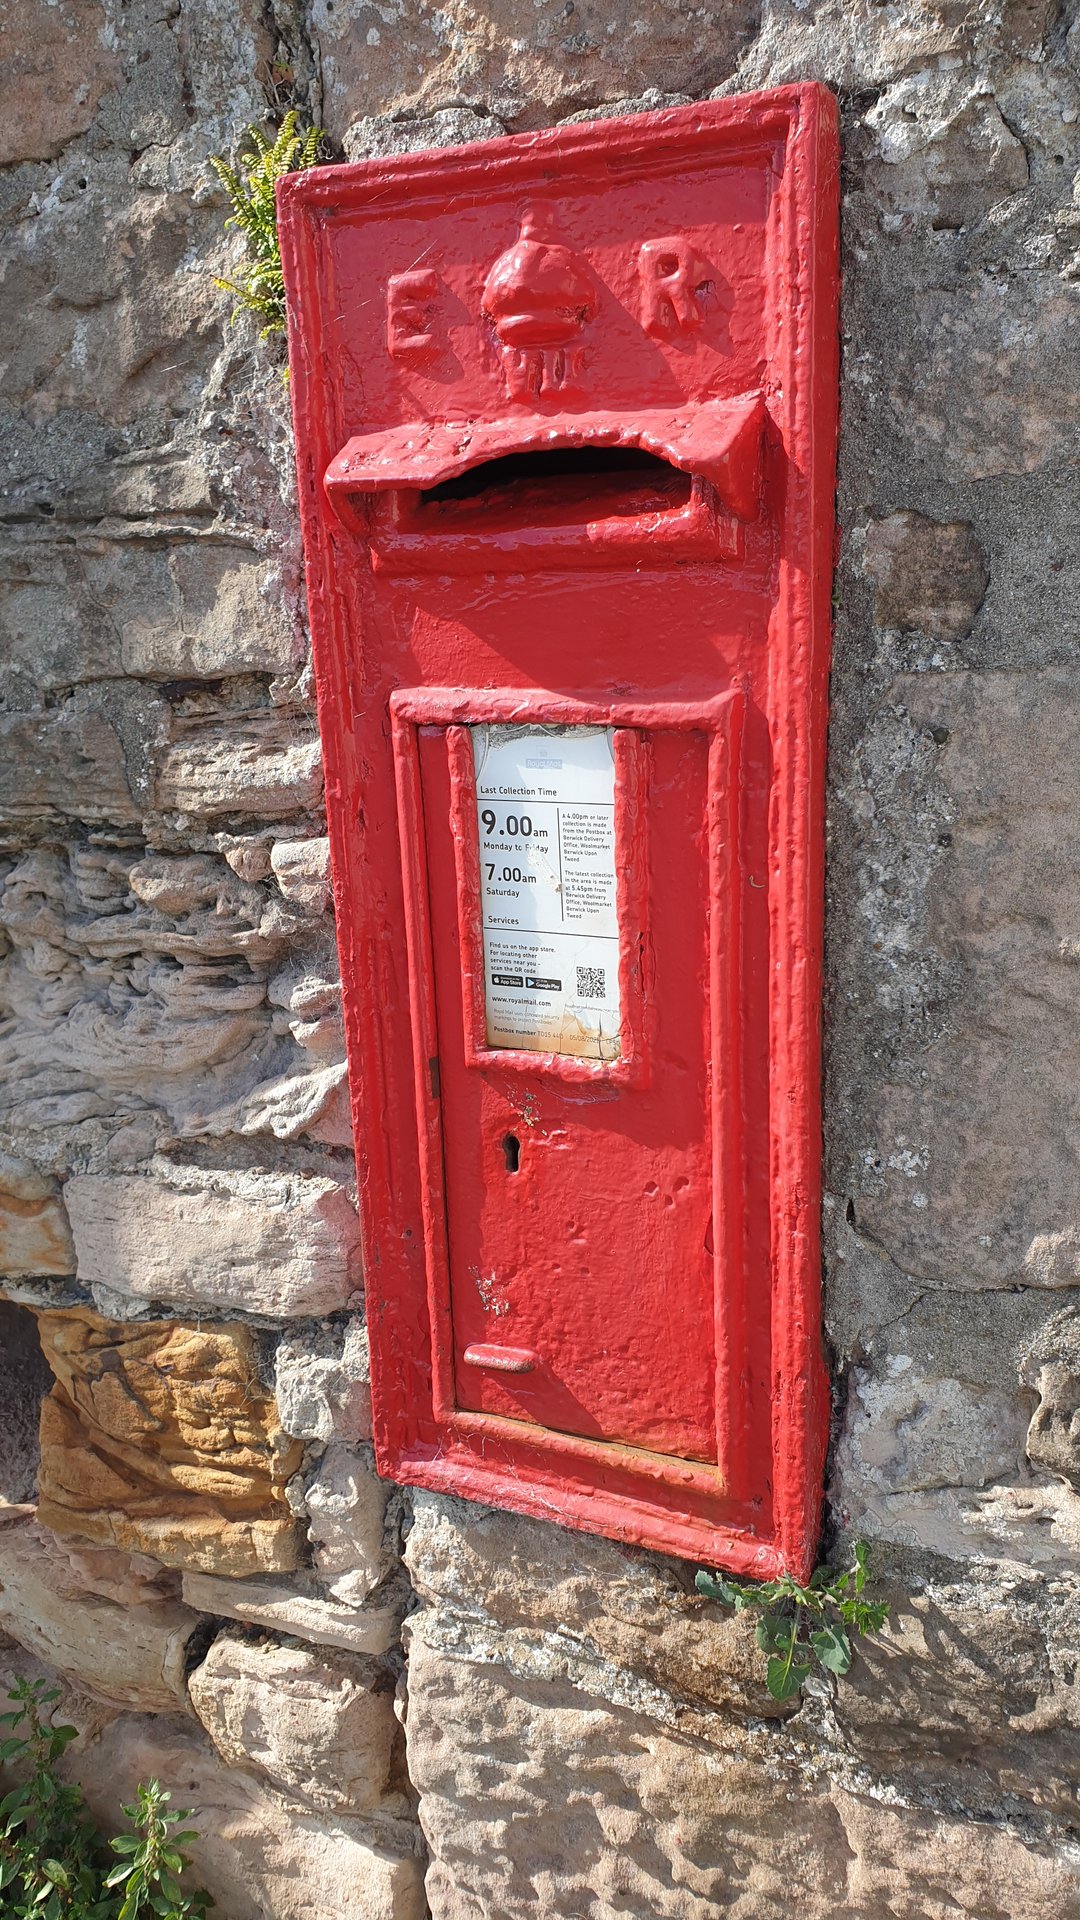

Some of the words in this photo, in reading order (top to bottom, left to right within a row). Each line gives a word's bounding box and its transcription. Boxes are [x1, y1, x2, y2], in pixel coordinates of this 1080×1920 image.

[386, 268, 438, 360] E
[638, 235, 702, 339] R
[480, 786, 497, 794] Last
[498, 786, 536, 796] Collection
[538, 788, 557, 796] Time
[481, 809, 548, 838] 9.00am
[484, 842, 512, 852] Monday
[525, 844, 548, 854] Fday
[484, 863, 537, 884] 7.00am
[486, 887, 520, 898] Saturday
[488, 916, 519, 925] Services
[492, 996, 551, 1006] www.royalmail.com
